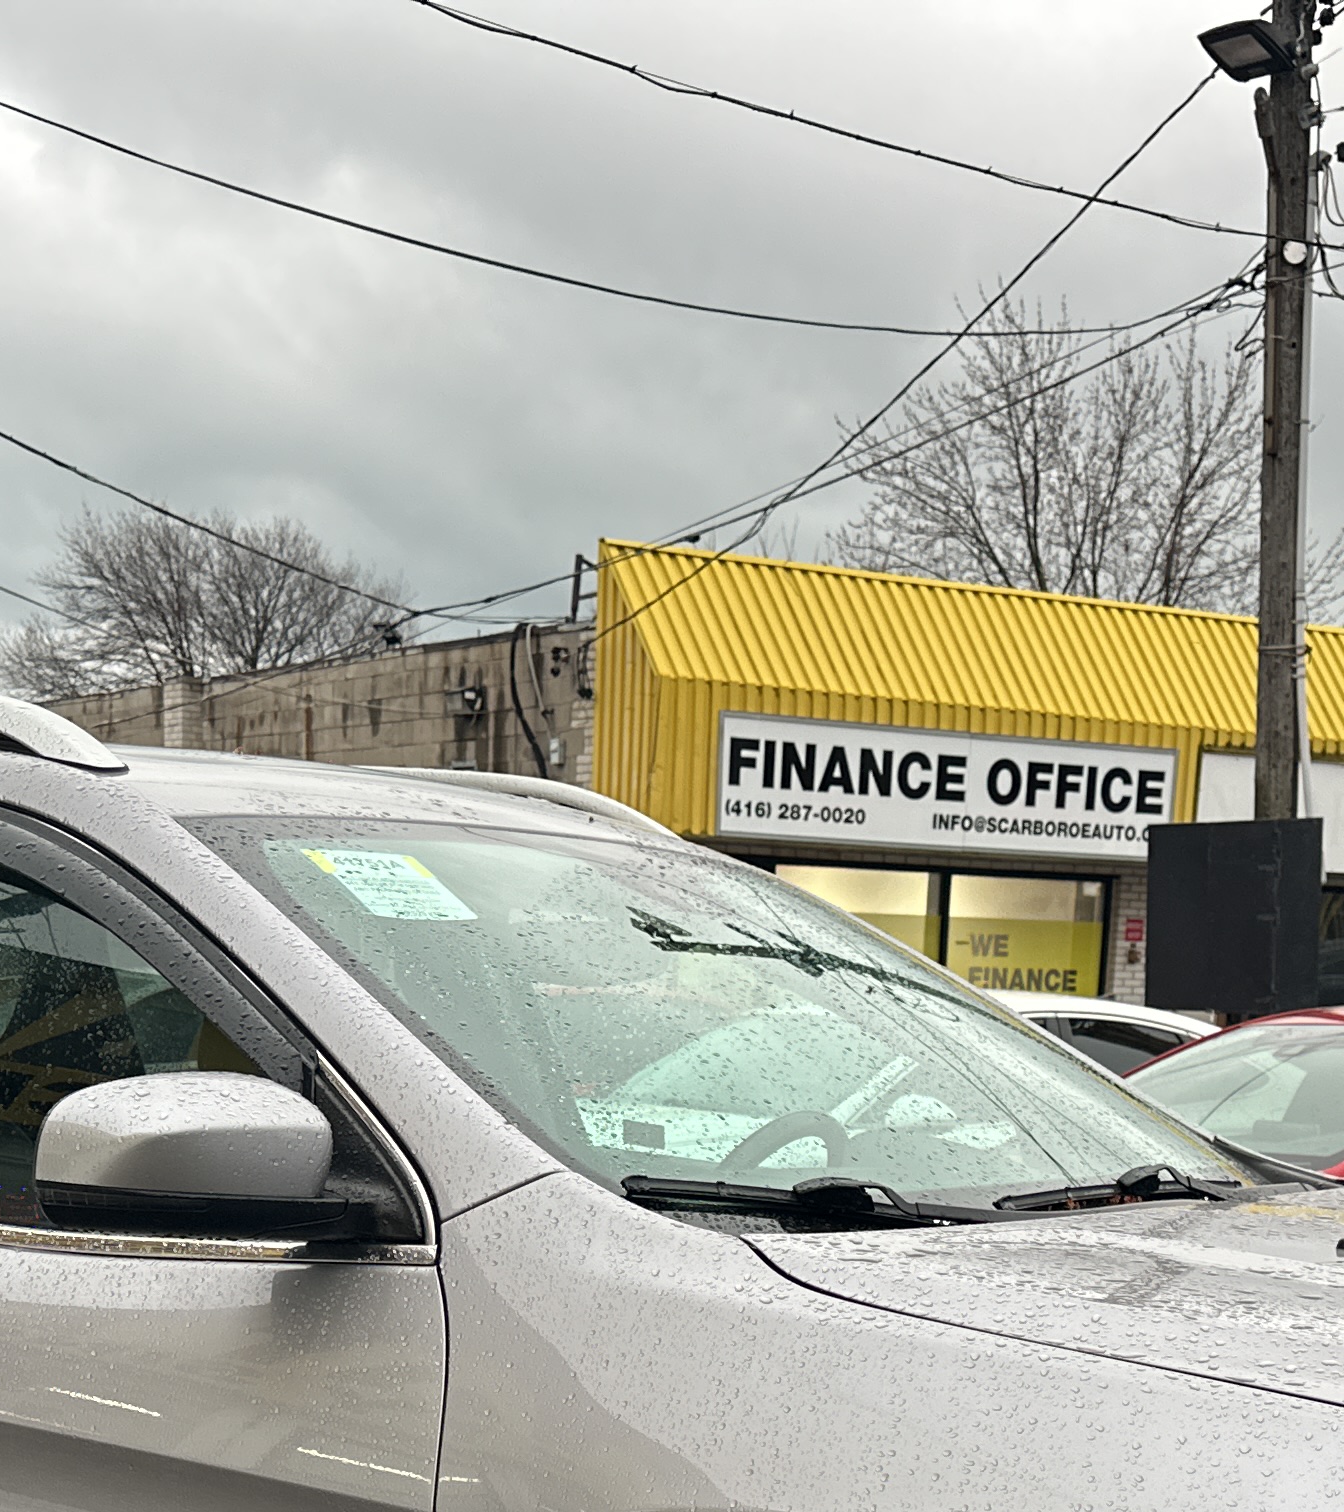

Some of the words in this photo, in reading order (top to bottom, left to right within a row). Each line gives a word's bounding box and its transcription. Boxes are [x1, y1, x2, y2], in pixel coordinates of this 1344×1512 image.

[728, 738, 968, 802] FINANCE
[987, 758, 1167, 816] OFFICE
[724, 799, 772, 820] (416)
[778, 803, 867, 826] 287-0020
[968, 966, 1078, 993] FINANCE
